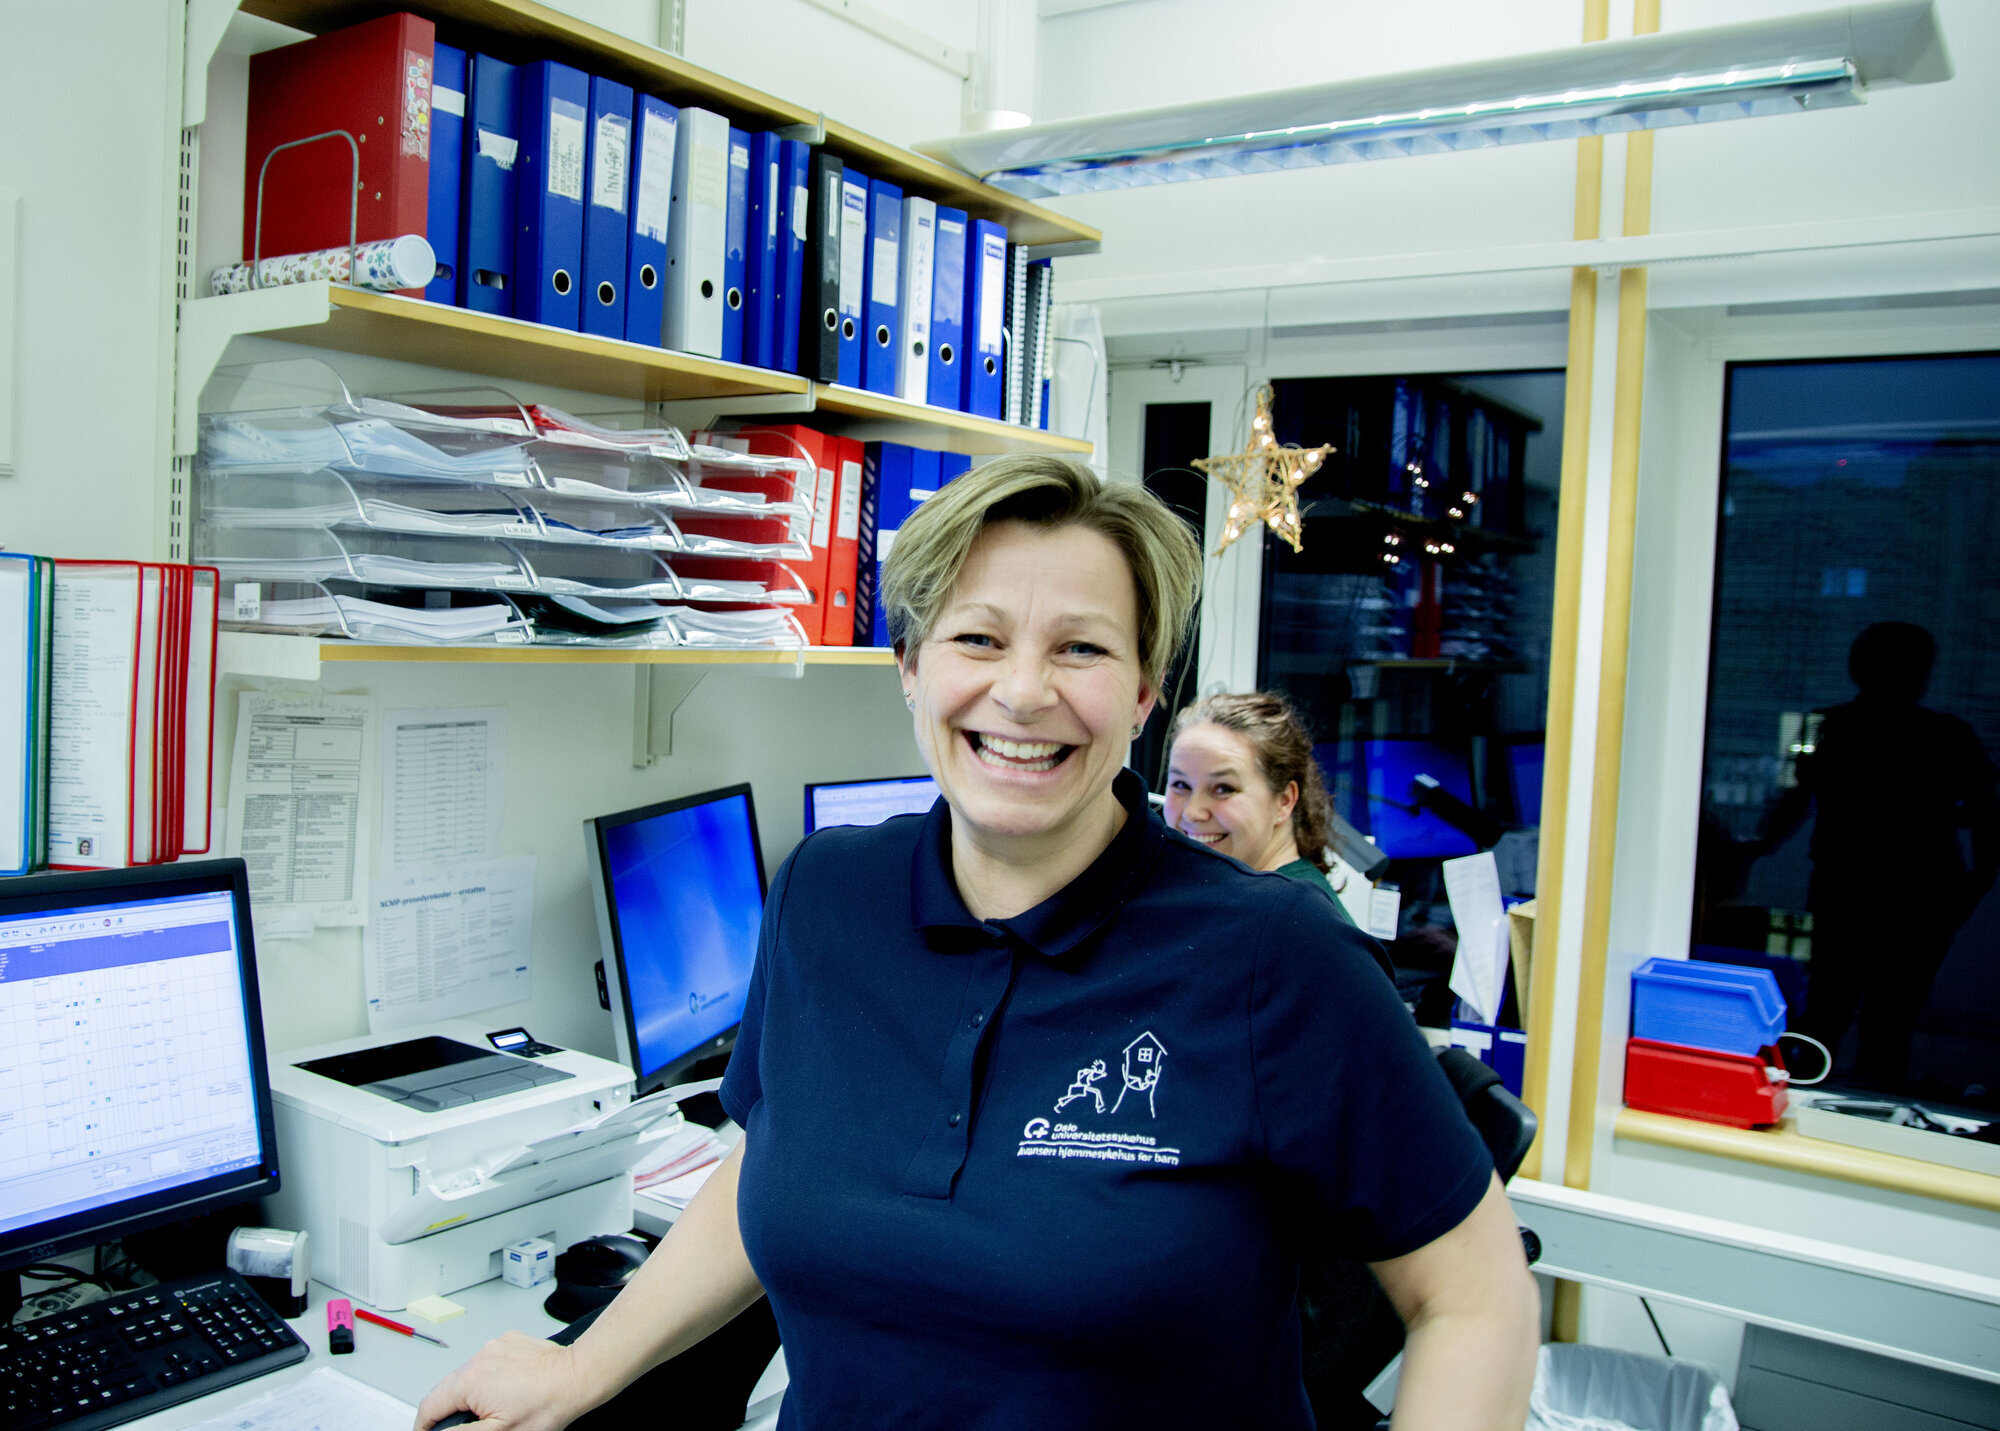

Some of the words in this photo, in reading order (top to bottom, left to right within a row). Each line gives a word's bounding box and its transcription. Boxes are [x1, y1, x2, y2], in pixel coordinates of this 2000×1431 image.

[1054, 1123, 1078, 1132] Oslo
[1051, 1131, 1156, 1146] universitetssykehus
[1017, 1147, 1057, 1157] Avansert
[1058, 1147, 1136, 1161] hjemmesykehus
[1137, 1152, 1152, 1162] for
[1154, 1152, 1180, 1166] barn
